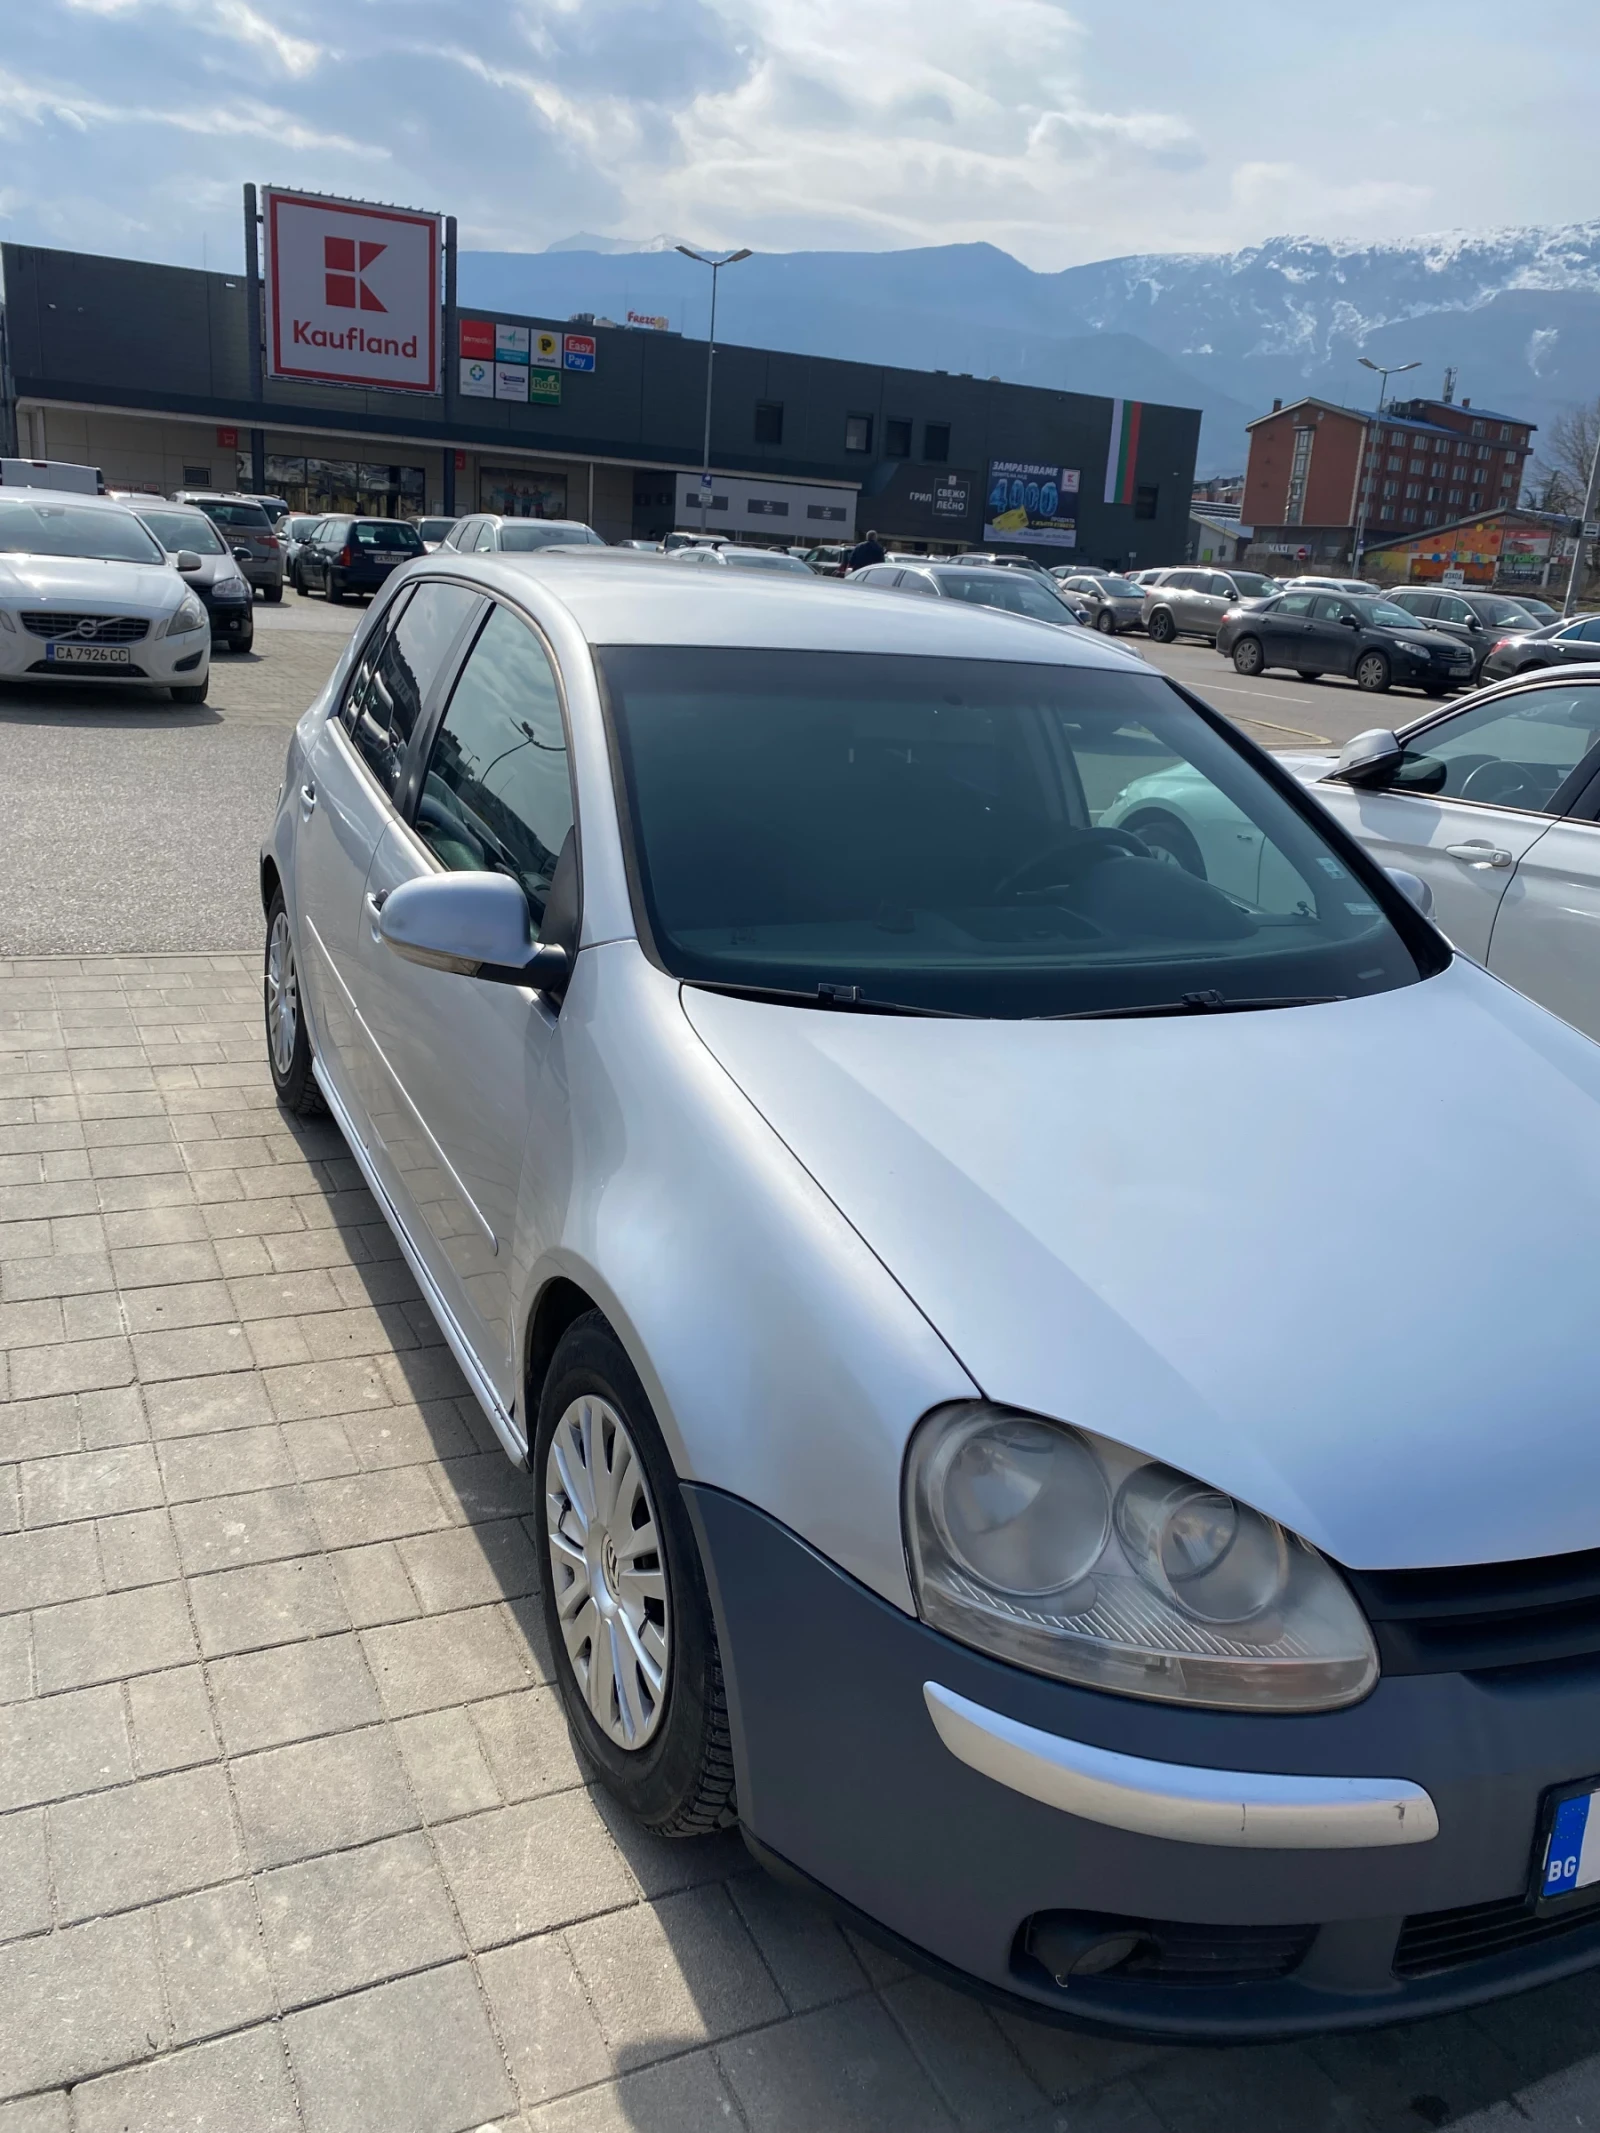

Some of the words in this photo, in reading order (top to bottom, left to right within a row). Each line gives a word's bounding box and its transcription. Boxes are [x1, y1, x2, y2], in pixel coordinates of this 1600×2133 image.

[293, 319, 417, 359] Kaufland
[568, 339, 592, 353] Easy
[568, 354, 586, 368] Pay
[992, 461, 1058, 476] ЗАМРАЗЯВАМЕ
[909, 491, 932, 502] ГРИЛ
[937, 488, 966, 499] СВЕЖО
[989, 478, 1059, 517] 4000
[936, 500, 965, 511] ЛЕСНО
[56, 647, 73, 659] CA
[76, 648, 108, 661] 7926
[110, 649, 127, 662] CC
[1547, 1855, 1577, 1883] BG
